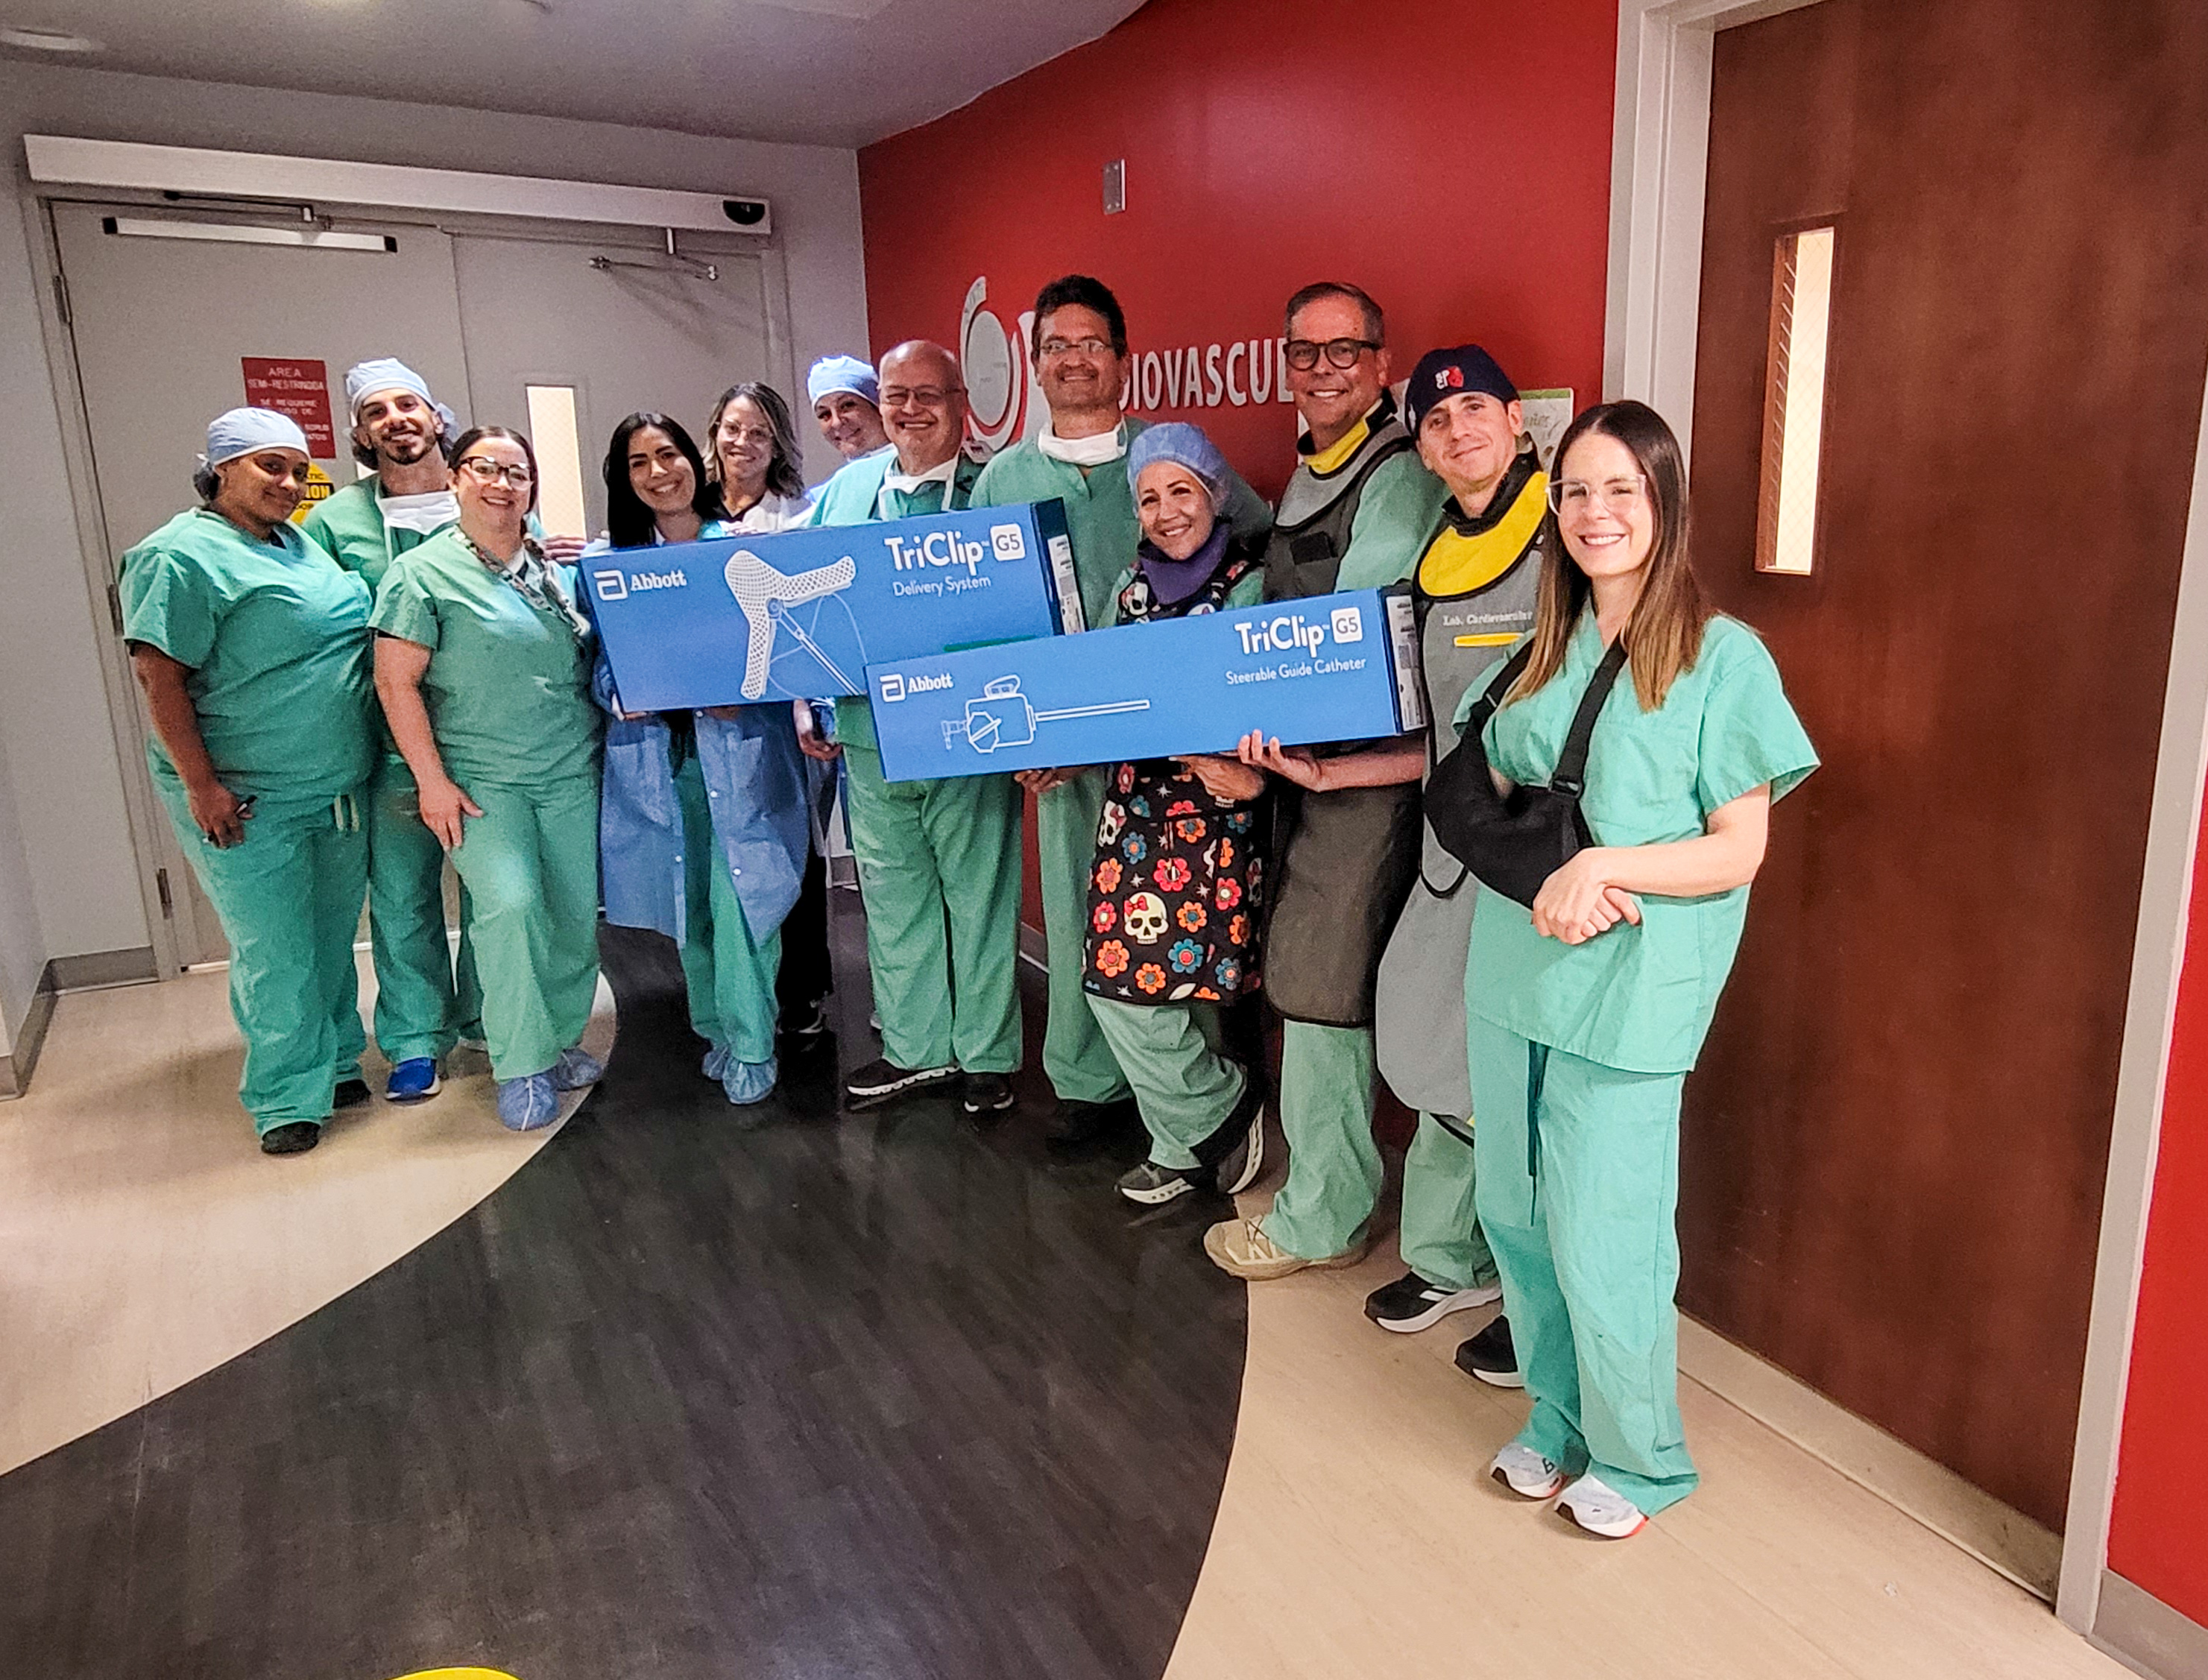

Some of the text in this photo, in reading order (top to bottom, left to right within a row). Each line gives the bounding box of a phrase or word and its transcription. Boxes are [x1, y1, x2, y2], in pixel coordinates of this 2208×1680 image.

[268, 366, 303, 378] AREA
[884, 531, 1021, 576] TriClip G5
[631, 569, 687, 591] Abbott
[893, 575, 991, 597] Delivery System
[1234, 616, 1358, 658] TriClip G5
[1226, 657, 1366, 685] Steerable Guide Catheter
[907, 673, 954, 693] Abbott
